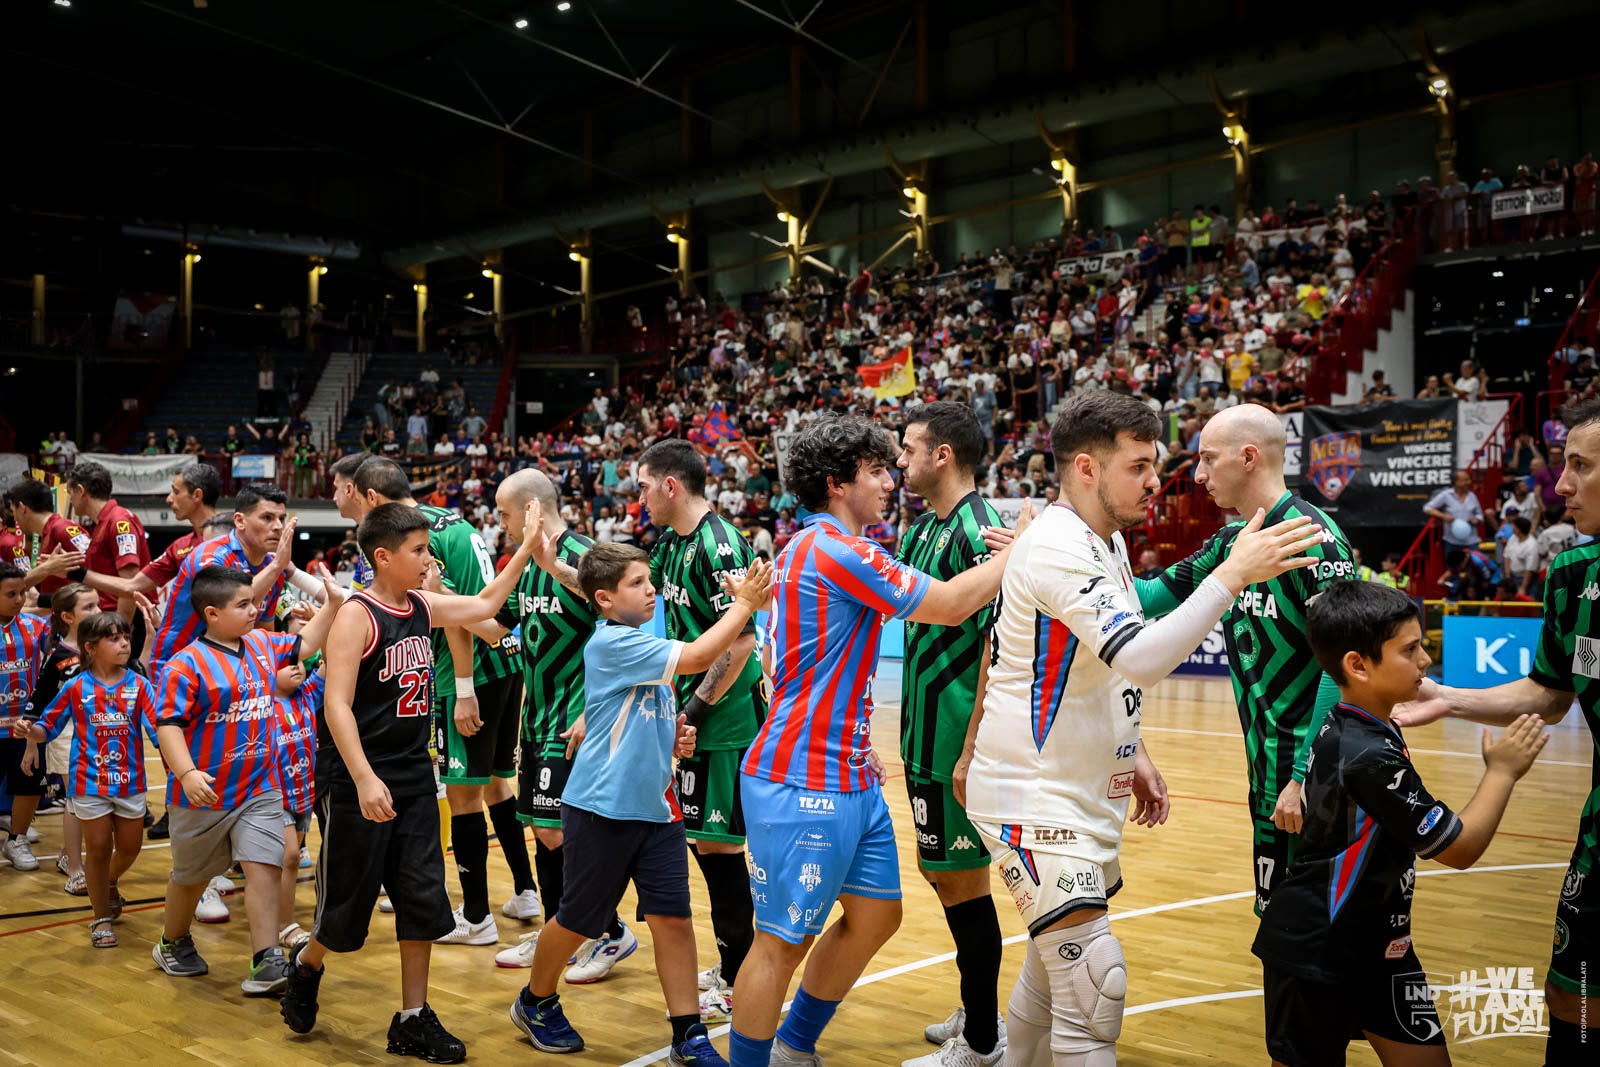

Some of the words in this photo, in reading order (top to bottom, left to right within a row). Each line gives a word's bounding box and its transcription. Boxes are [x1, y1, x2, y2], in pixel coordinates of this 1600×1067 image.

[1311, 437, 1360, 463] META
[1404, 442, 1452, 454] VINCERE
[1387, 454, 1452, 469] VINCERE
[1369, 469, 1452, 487] VINCERE
[470, 533, 496, 586] 6
[397, 670, 430, 718] 23
[103, 728, 129, 737] BACCO
[437, 728, 444, 749] 6
[93, 750, 122, 766] Deco
[285, 757, 310, 778] Deco
[539, 767, 551, 791] 9
[799, 797, 836, 810] TESTA
[912, 796, 928, 826] 18
[1418, 807, 1442, 834] Sorbello
[1034, 829, 1077, 841] TESTA
[1257, 856, 1275, 890] 17
